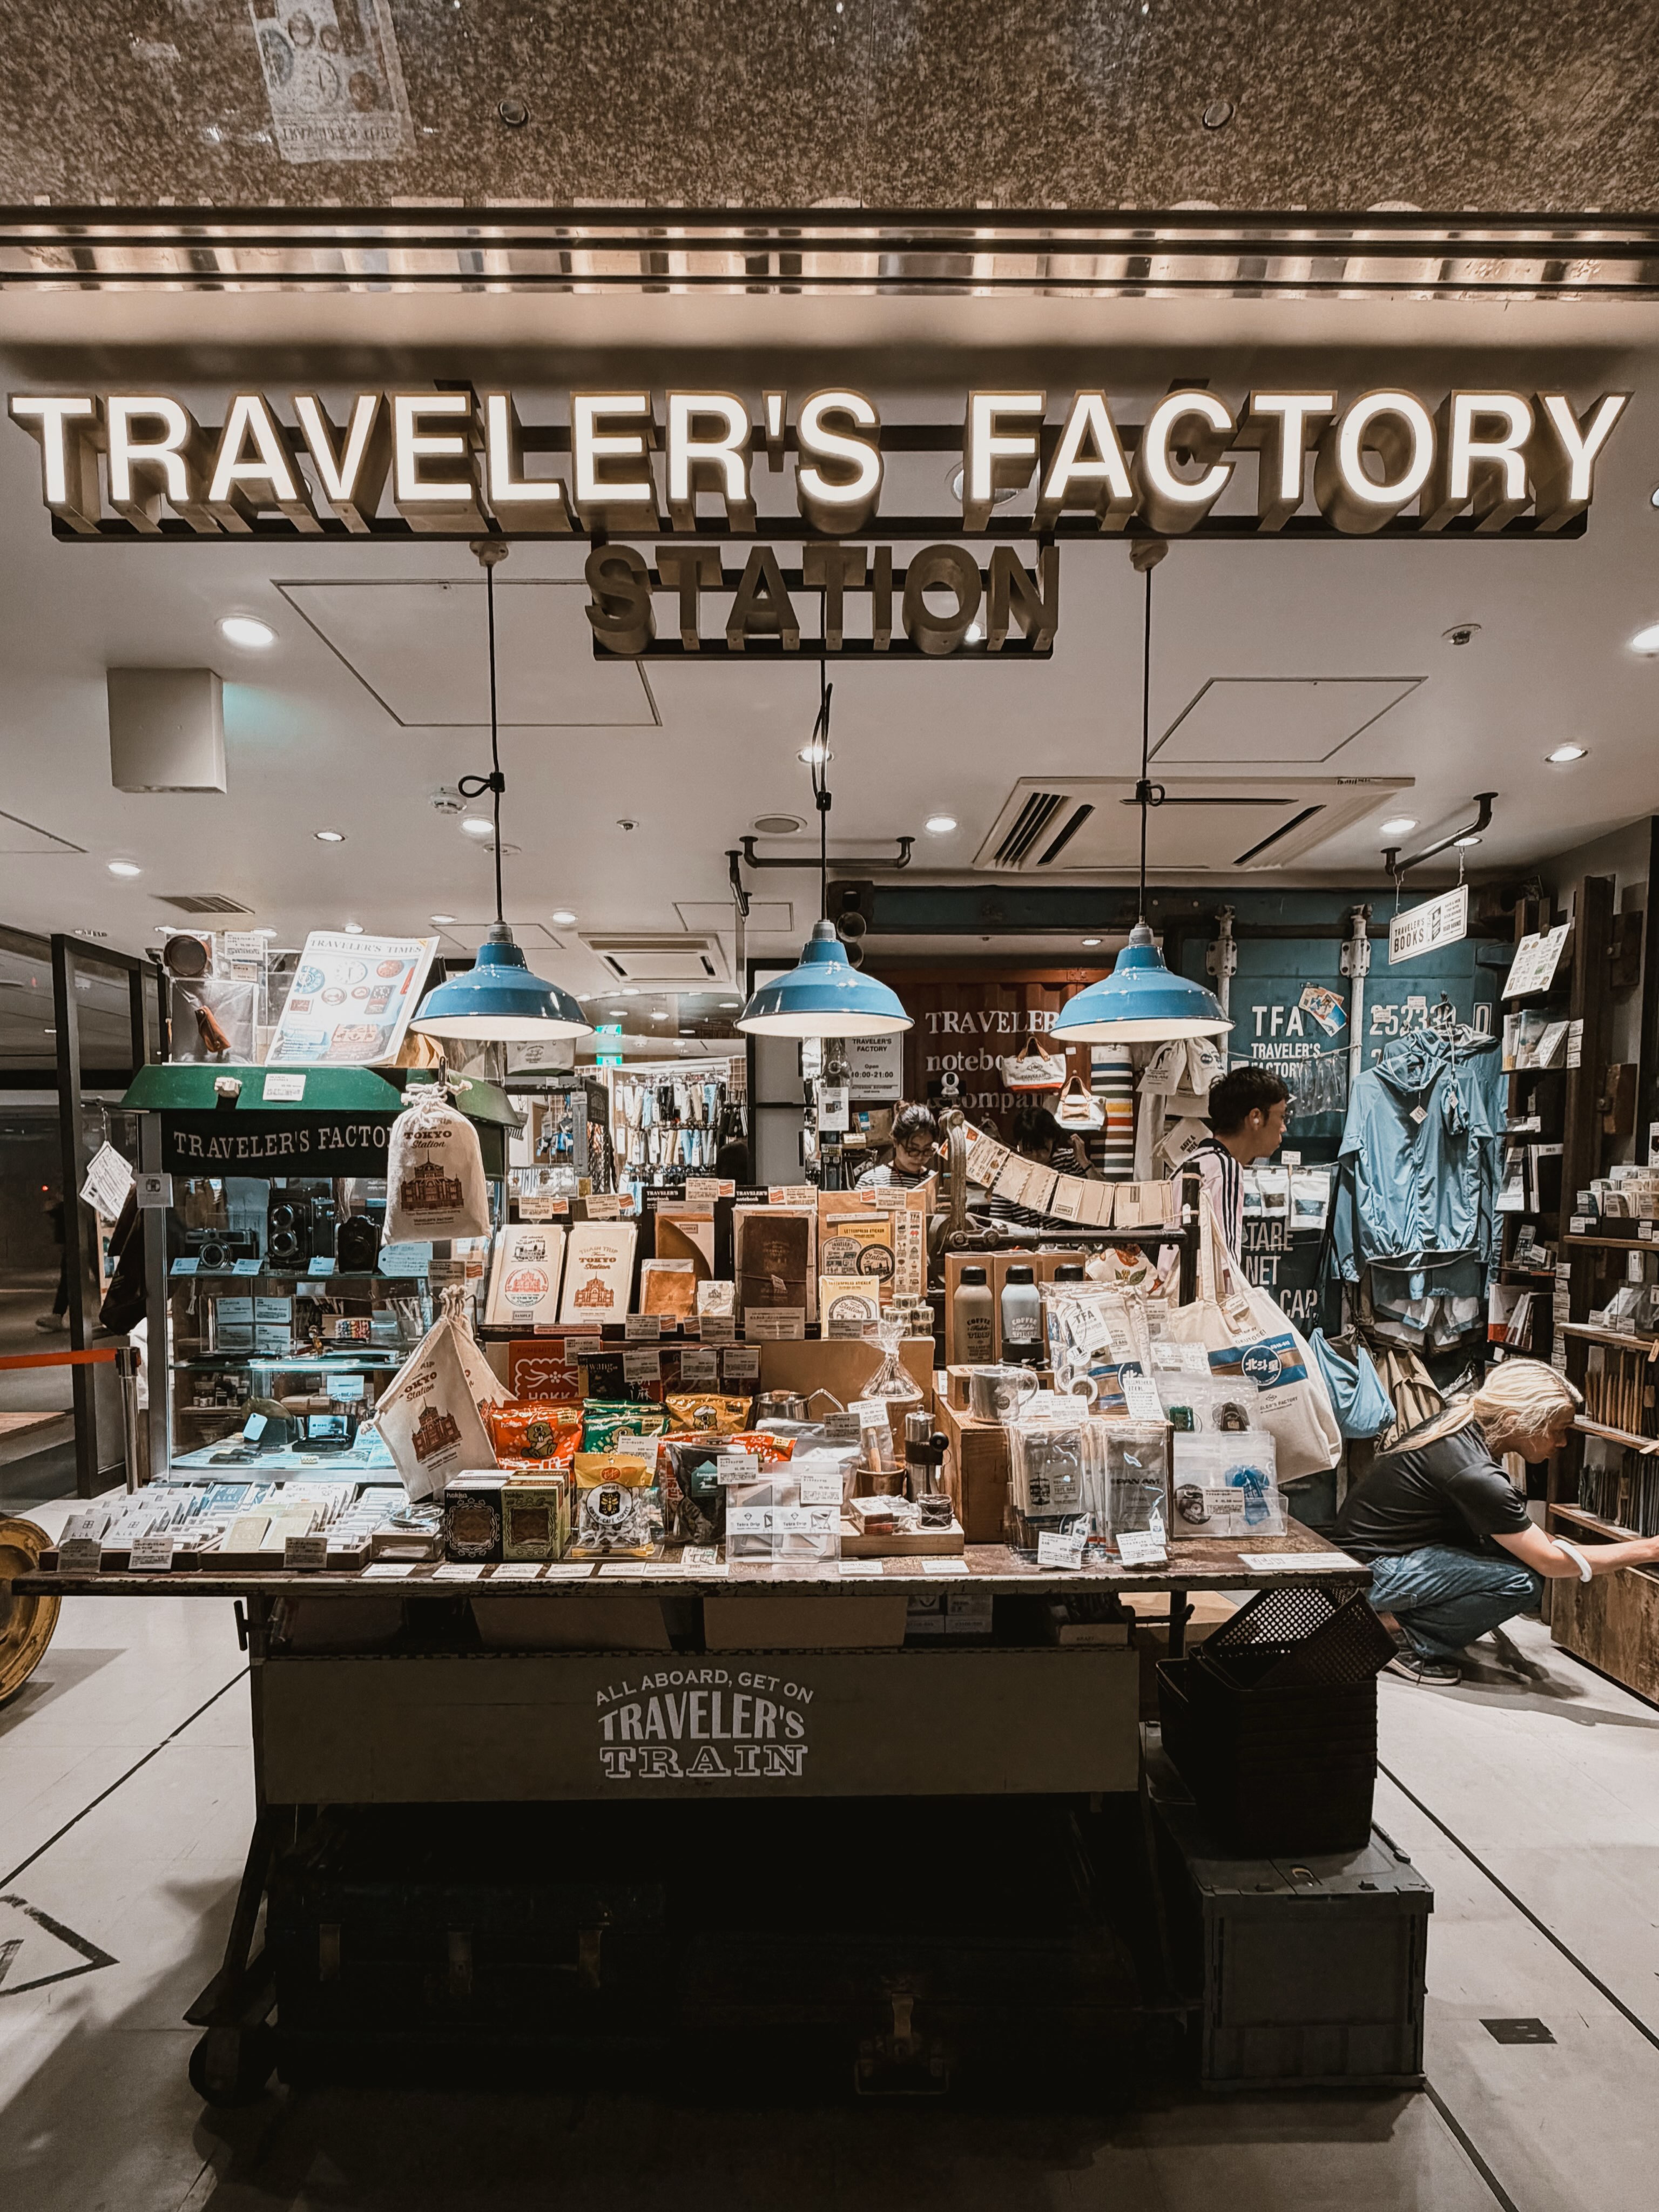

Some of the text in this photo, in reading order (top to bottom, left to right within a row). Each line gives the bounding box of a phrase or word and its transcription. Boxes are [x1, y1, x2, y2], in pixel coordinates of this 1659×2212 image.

[9, 389, 1632, 503] TRAVELER'S FACTORY
[585, 544, 1060, 636] STATION
[1395, 918, 1425, 937] TRAVELER'S
[311, 940, 423, 954] TRAVELER'S TIMES
[1394, 928, 1424, 953] BOOKS
[925, 1010, 1060, 1034] TRAVELER
[1252, 1006, 1304, 1036] TFA
[926, 1047, 1016, 1072] notebo
[1251, 1043, 1321, 1059] TRAVELER'S
[173, 1125, 392, 1160] TRAVELER'S FACTO
[403, 1130, 452, 1139] TOKYO
[411, 1139, 447, 1149] Station
[1246, 1222, 1293, 1251] TARE
[864, 1252, 889, 1262] Station
[1246, 1256, 1281, 1285] NET
[839, 1302, 865, 1315] Station
[1245, 1357, 1280, 1373] 北斗星
[406, 1383, 435, 1402] Station
[597, 1669, 814, 1707] ALL ABOARD, GET ON
[598, 1690, 805, 1741] TRAVELER'S
[599, 1744, 808, 1778] TRAIN
